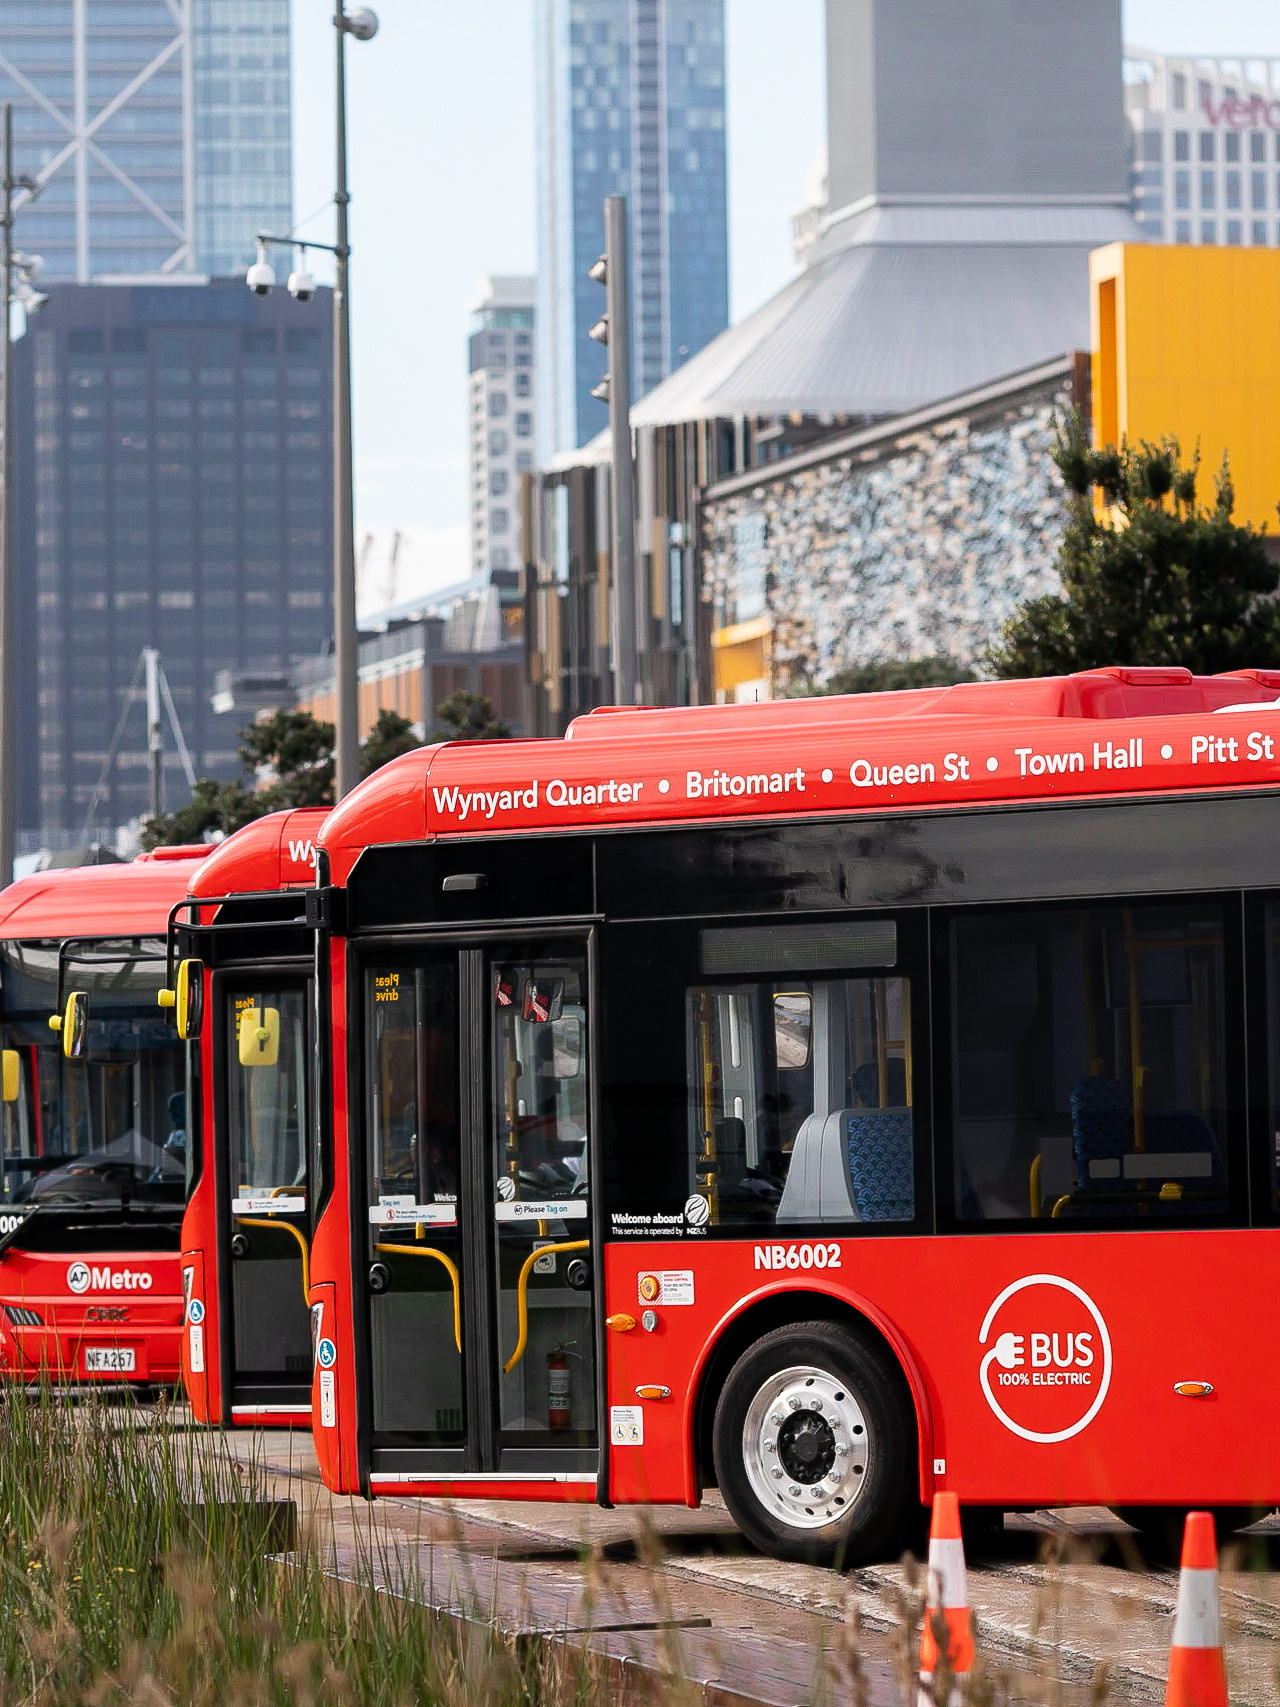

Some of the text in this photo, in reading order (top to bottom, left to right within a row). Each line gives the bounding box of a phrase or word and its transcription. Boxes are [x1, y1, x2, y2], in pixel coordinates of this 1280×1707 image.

[432, 732, 1274, 820] Wynyard Quarter Britomart Queen St Town Hall Pitt St
[524, 1205, 545, 1213] Please
[546, 1205, 558, 1214] Tag
[612, 1213, 684, 1224] Welcome aboard
[612, 1226, 623, 1235] This
[624, 1227, 643, 1235] service
[650, 1226, 675, 1236] operated
[676, 1226, 684, 1236] by
[754, 1243, 842, 1270] NB6002
[92, 1266, 153, 1290] Metro
[1030, 1332, 1094, 1368] BUS
[87, 1352, 132, 1368] NFA267
[998, 1372, 1092, 1386] 100% ELECTRIC
